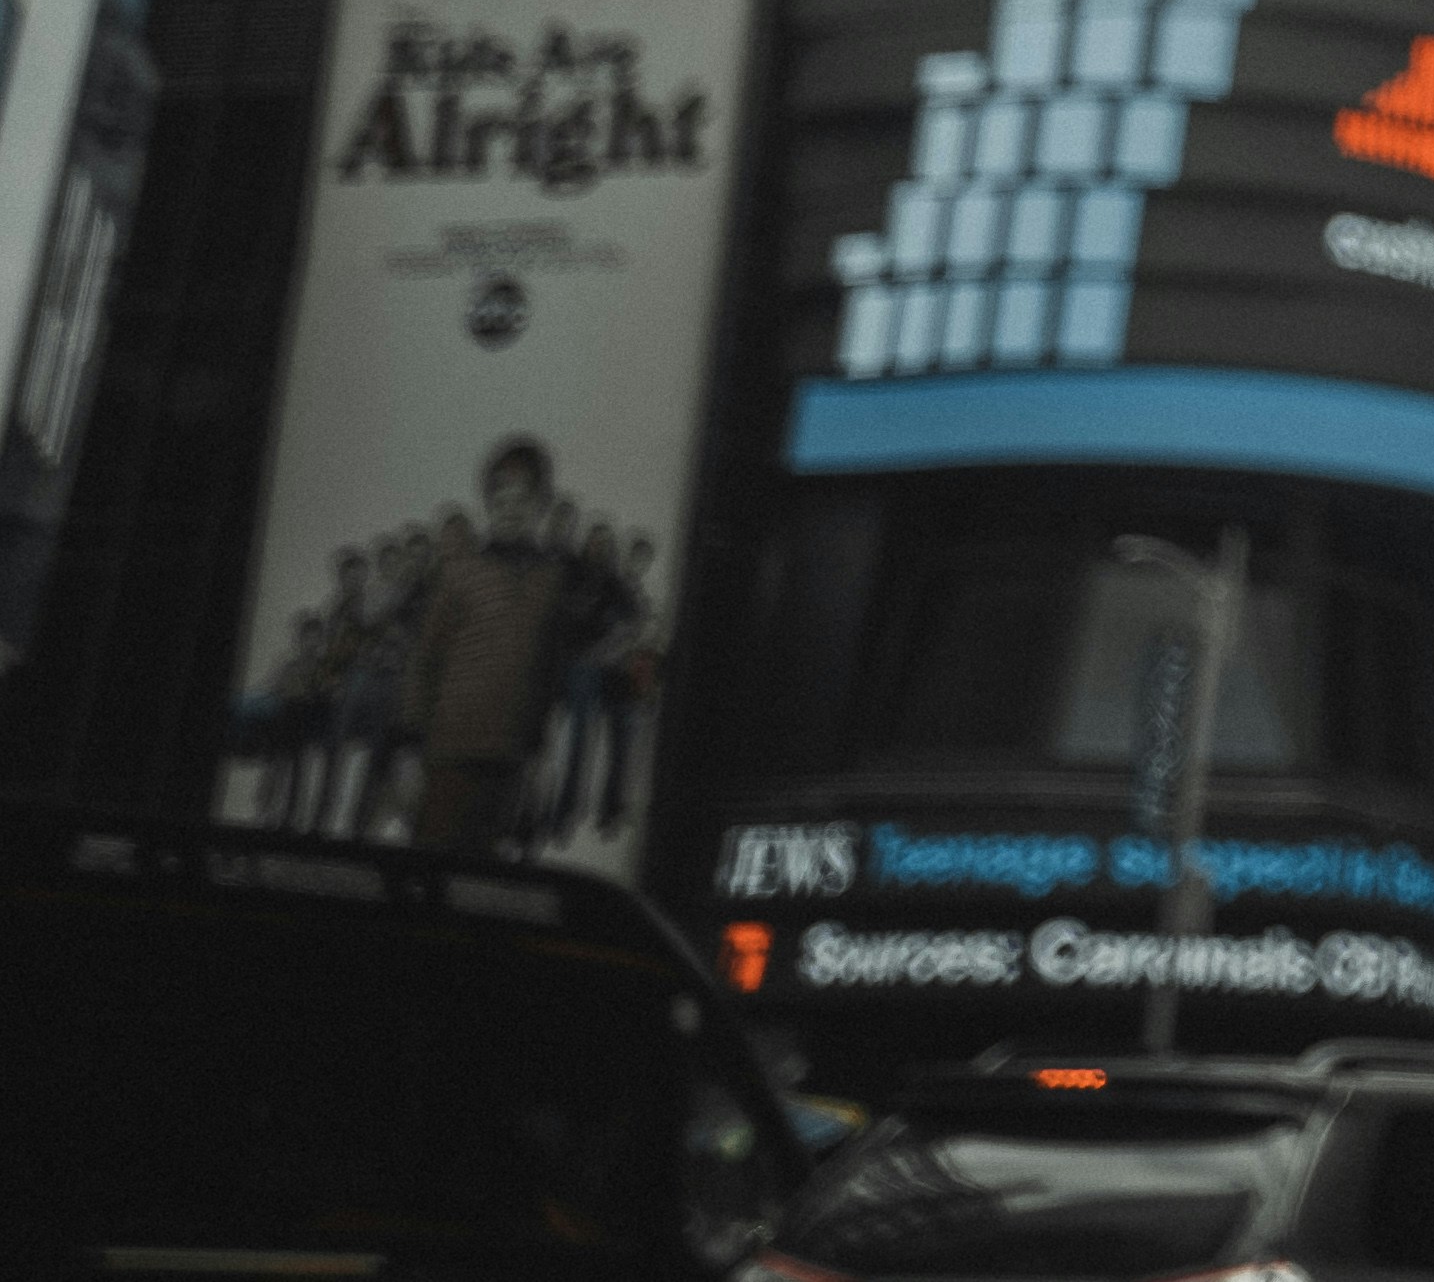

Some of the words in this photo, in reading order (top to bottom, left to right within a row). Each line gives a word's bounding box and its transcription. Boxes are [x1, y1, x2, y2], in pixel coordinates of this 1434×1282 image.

[334, 66, 712, 200] Alright
[868, 822, 1097, 898] Teenage
[1110, 834, 1342, 904] supect
[802, 918, 1023, 986] Sources:
